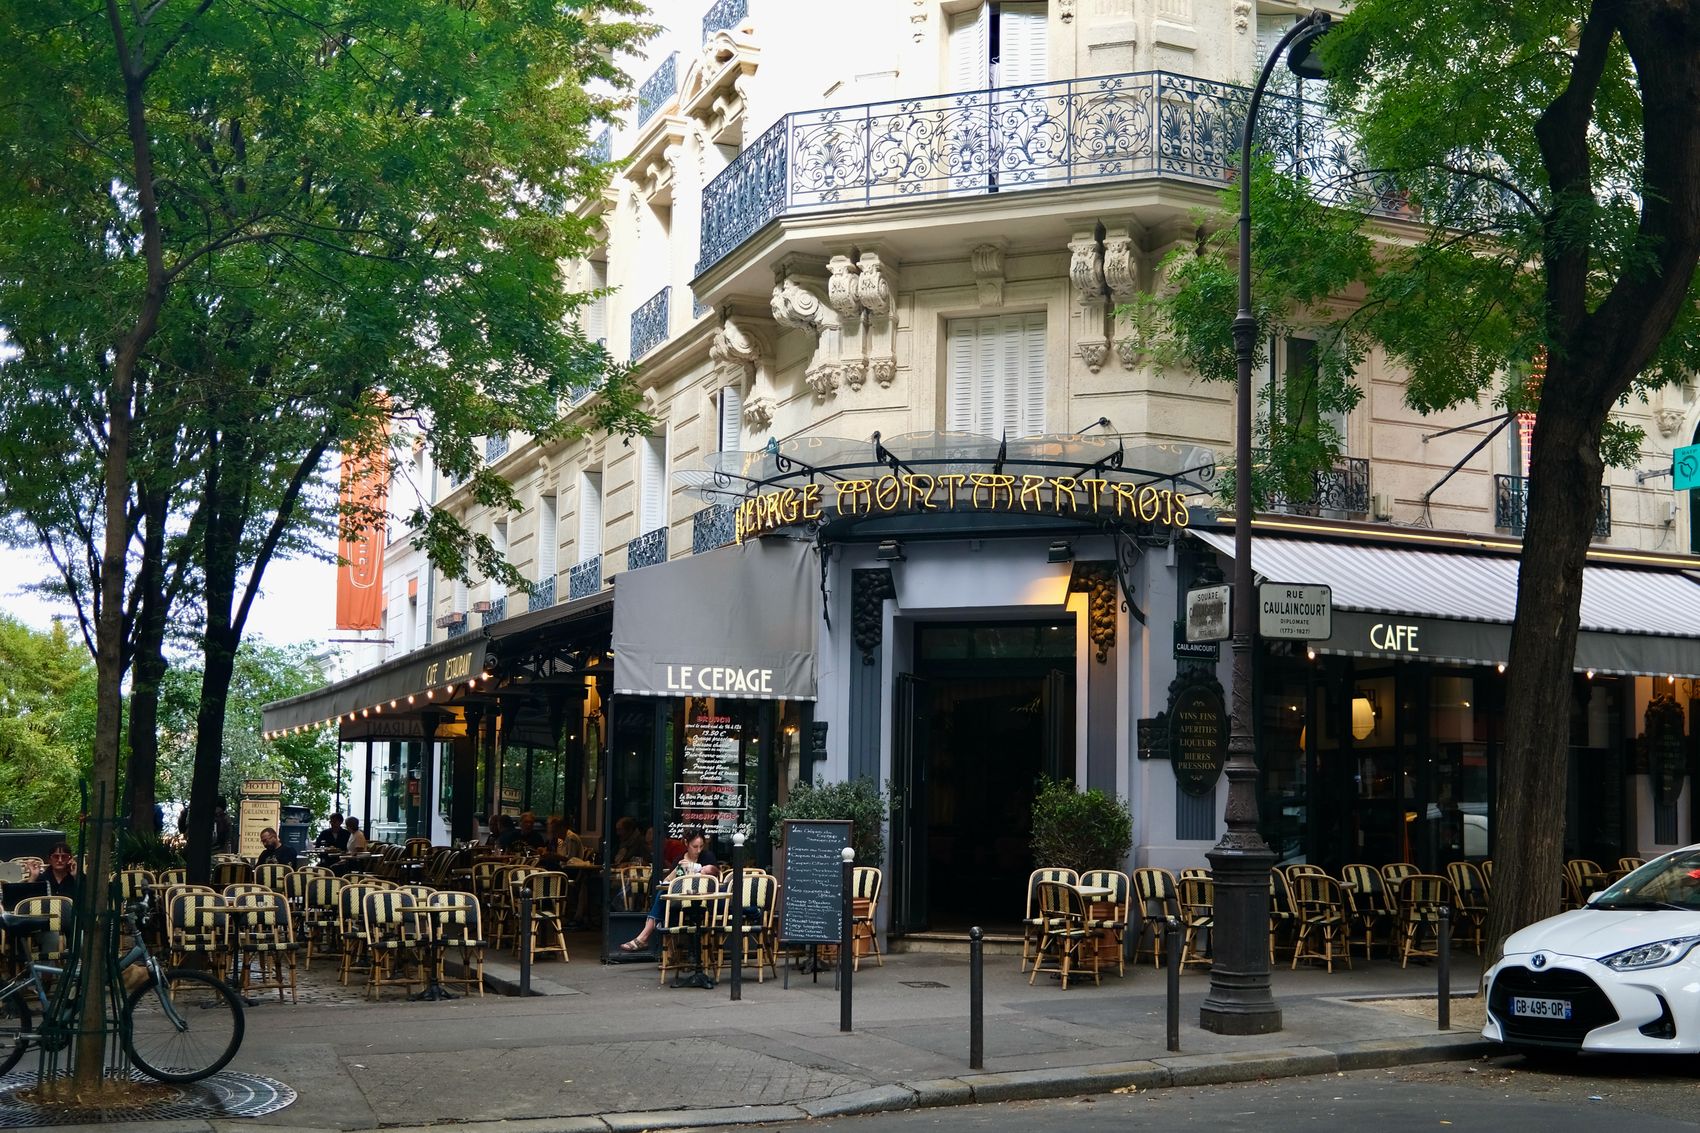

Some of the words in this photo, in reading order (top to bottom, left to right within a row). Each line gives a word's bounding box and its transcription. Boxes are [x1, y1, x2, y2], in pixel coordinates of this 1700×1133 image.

[834, 473, 1189, 527] MONTMARTROIS
[1197, 591, 1219, 602] SQUARE
[1286, 590, 1304, 599] RUE
[1263, 601, 1326, 617] CAULAINCOURT
[1280, 618, 1310, 626] DIPLOMATE
[1370, 623, 1419, 652] CAFE
[1176, 643, 1217, 653] CAULAINCOURT
[667, 666, 693, 690] LE
[698, 667, 773, 693] CEPAGE
[1180, 712, 1198, 720] VINS
[1199, 712, 1217, 720] FINS
[1181, 725, 1217, 733] APERITIFS
[1180, 738, 1217, 747] LIQUEURS
[1178, 761, 1216, 769] PRESSION
